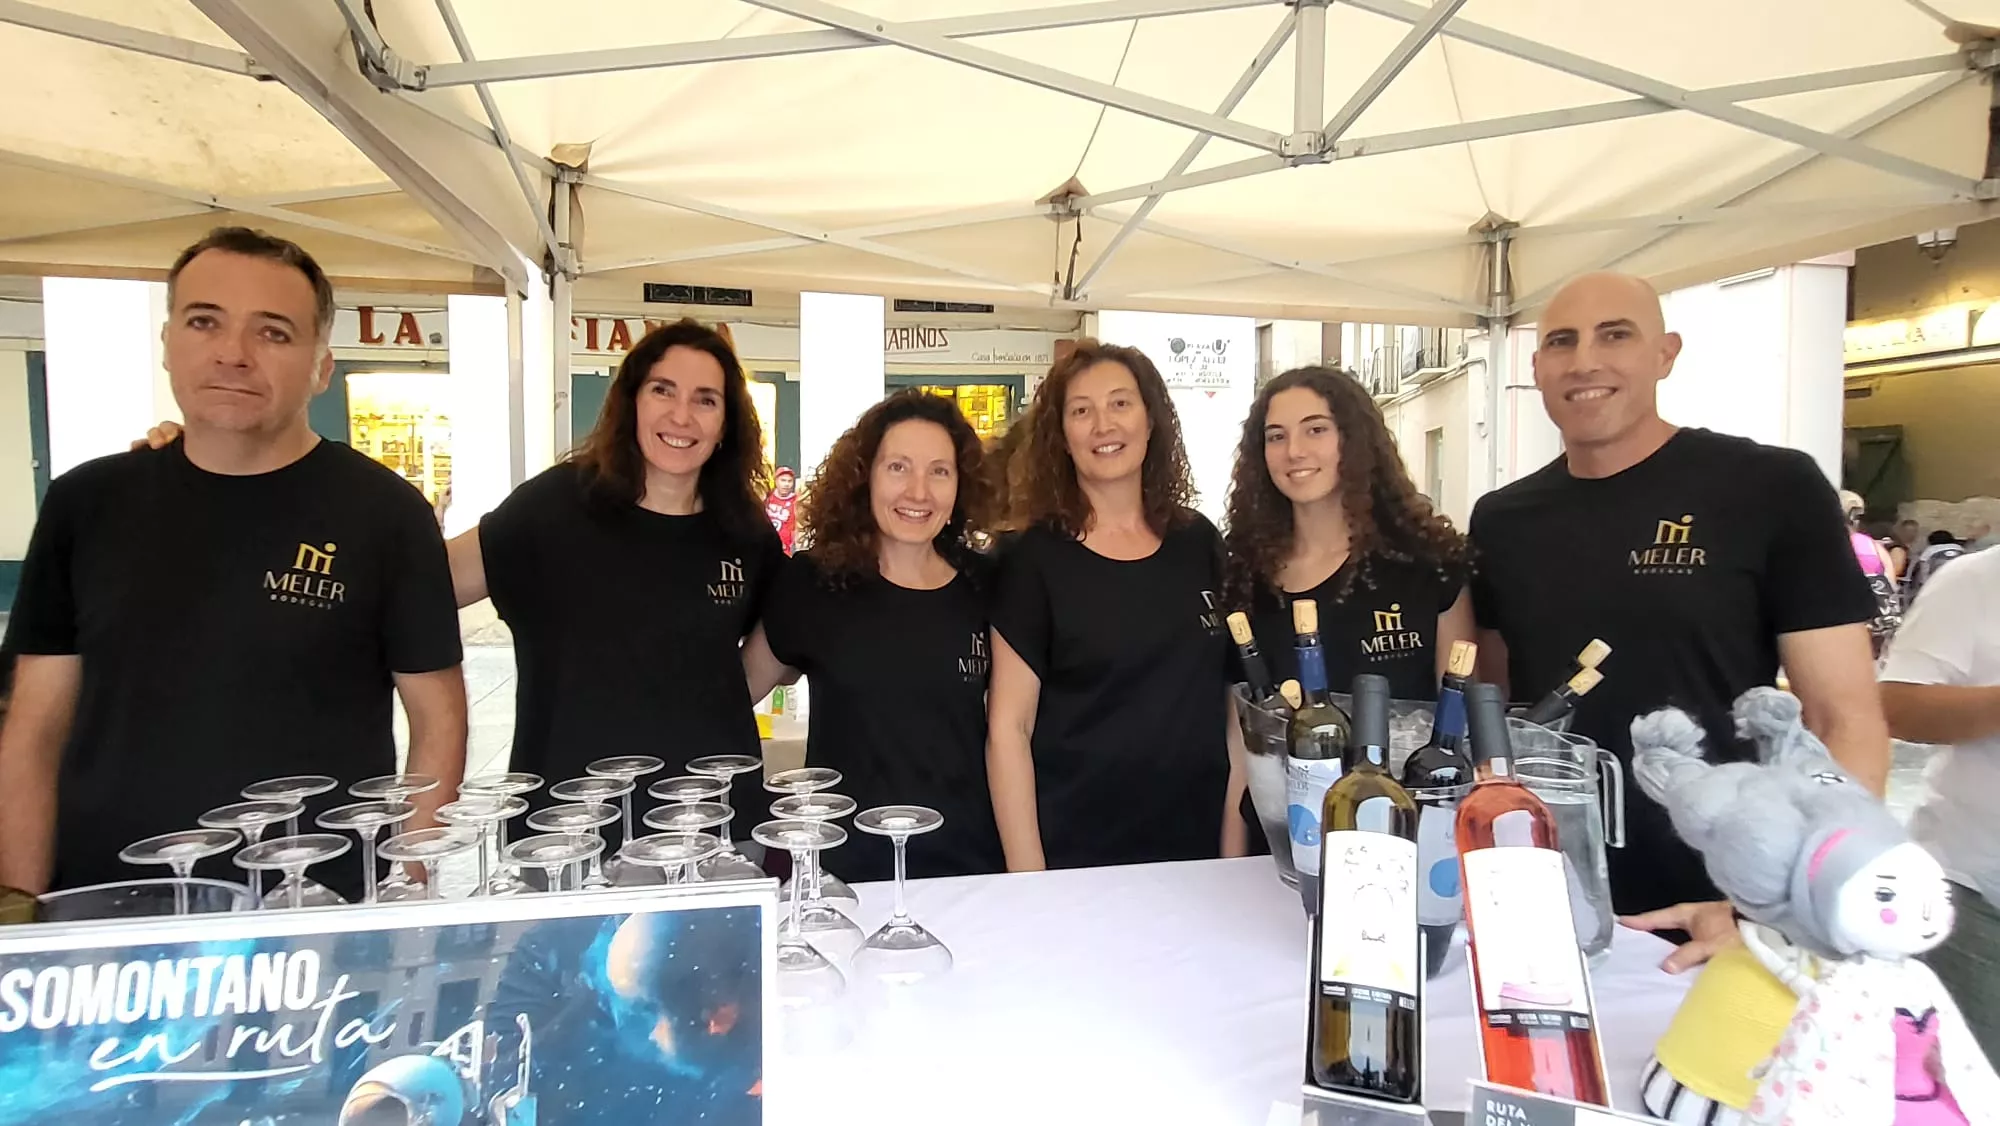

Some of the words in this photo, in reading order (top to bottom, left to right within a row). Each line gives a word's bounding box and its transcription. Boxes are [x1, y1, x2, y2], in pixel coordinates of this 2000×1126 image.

[358, 306, 423, 344] LA
[1628, 547, 1706, 566] MELER
[263, 570, 346, 603] MELER
[1360, 631, 1424, 655] MELER
[0, 948, 321, 1033] SOMONTANO
[89, 1033, 201, 1071] en
[225, 974, 398, 1064] ruta
[1486, 1099, 1527, 1121] RUTA
